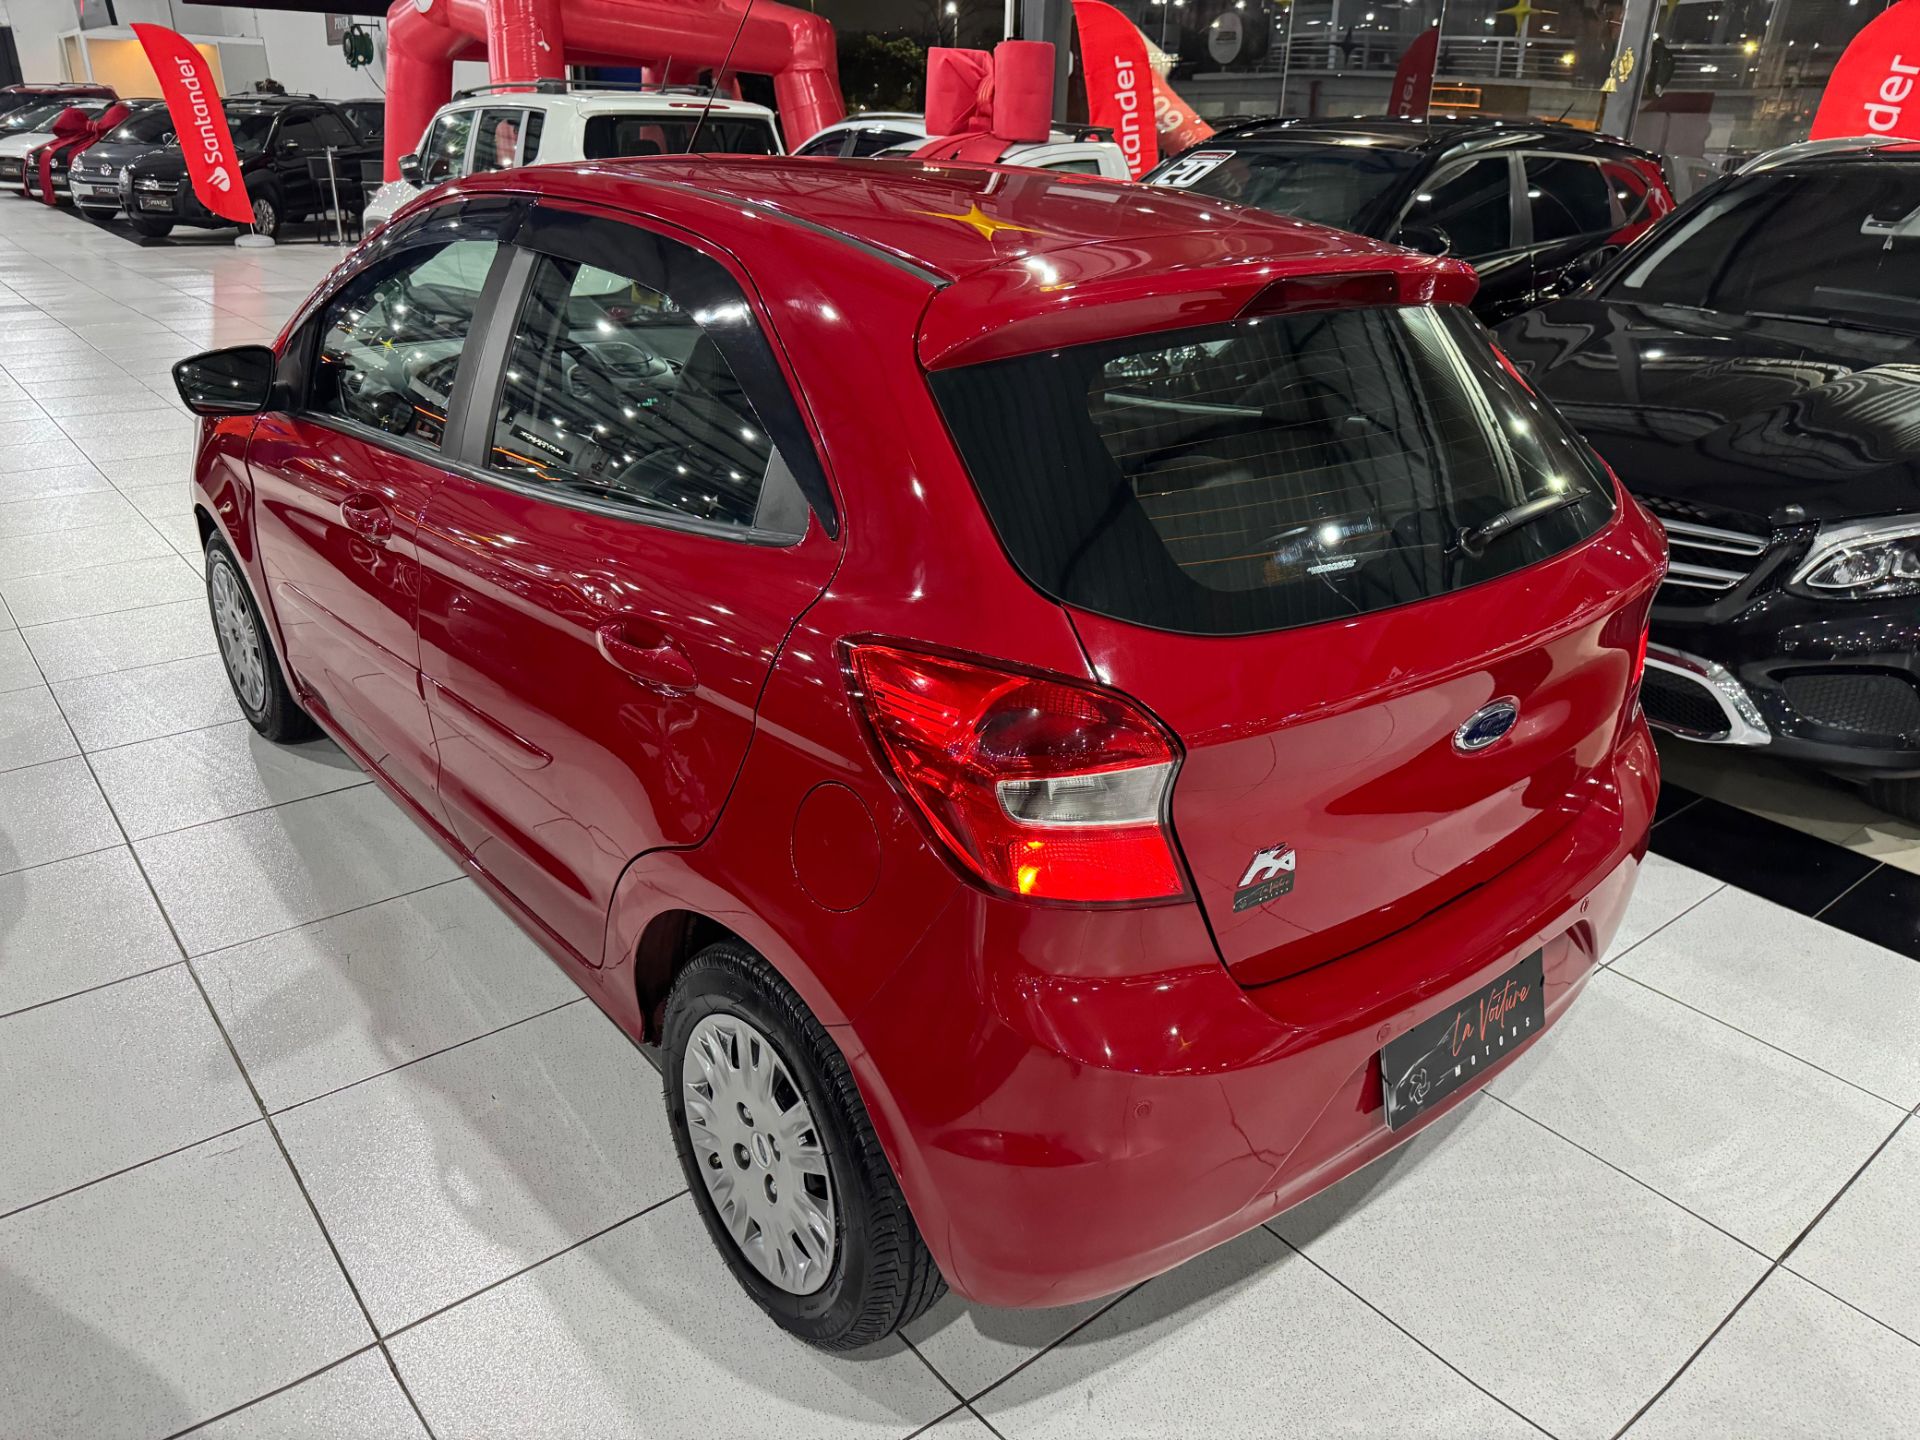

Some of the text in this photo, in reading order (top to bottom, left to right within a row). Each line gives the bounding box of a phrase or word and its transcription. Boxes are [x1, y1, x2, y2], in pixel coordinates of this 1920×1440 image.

[174, 55, 223, 164] Santander
[1862, 54, 1920, 138] der
[1479, 979, 1531, 1041] Voiture
[1454, 1016, 1531, 1078] MOTORS
